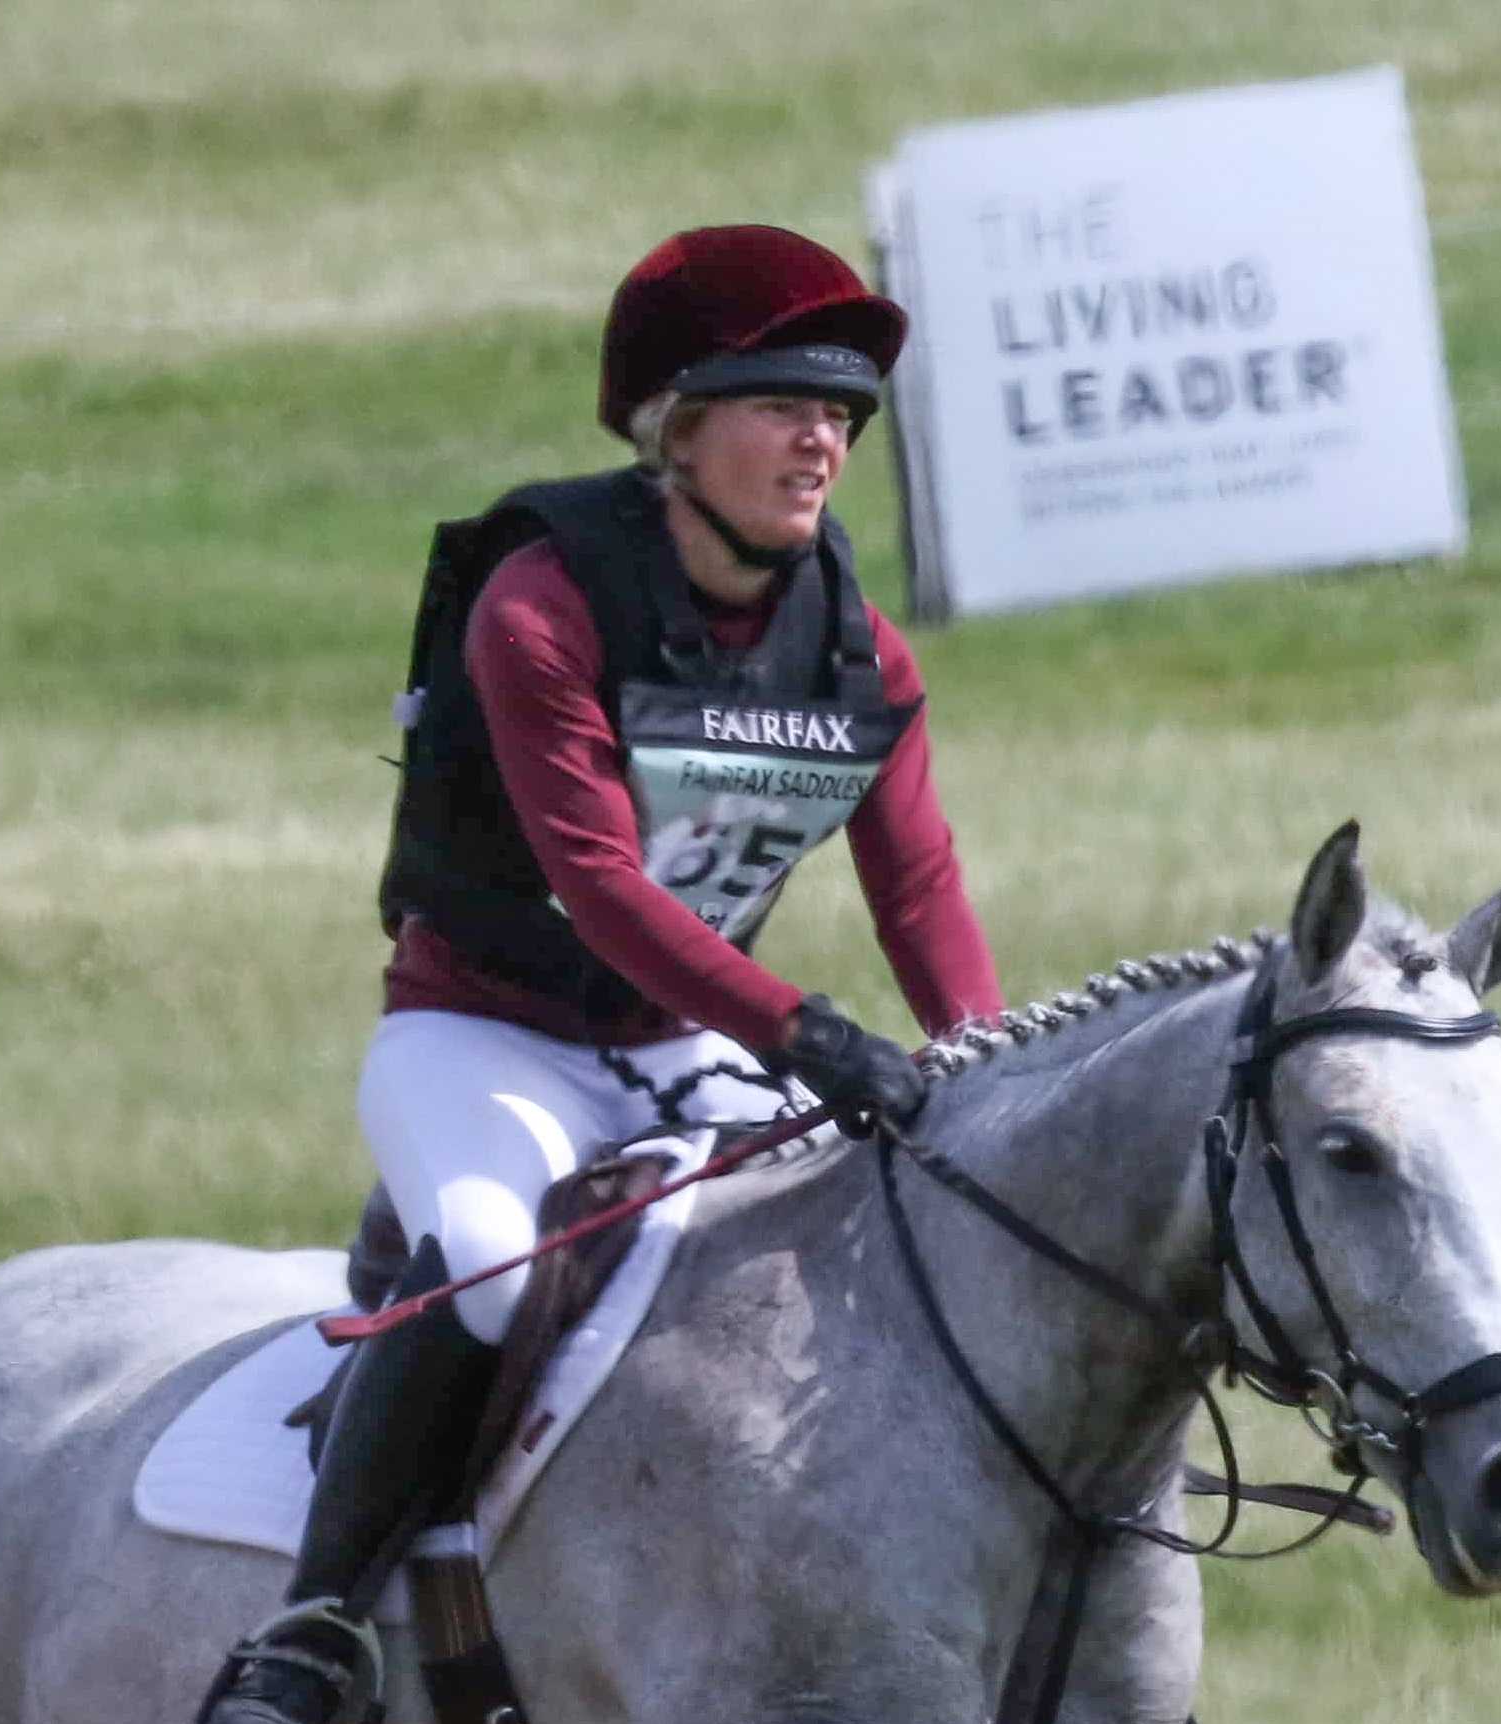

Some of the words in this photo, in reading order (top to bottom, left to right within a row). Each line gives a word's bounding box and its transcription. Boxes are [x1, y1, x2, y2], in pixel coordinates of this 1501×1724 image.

[977, 184, 1118, 268] THE
[994, 260, 1275, 353] LIVING
[1002, 339, 1349, 444] LEADER
[702, 707, 855, 752] FAIRFAX
[679, 761, 774, 797] FAIRFAX
[775, 770, 868, 800] SADDLES
